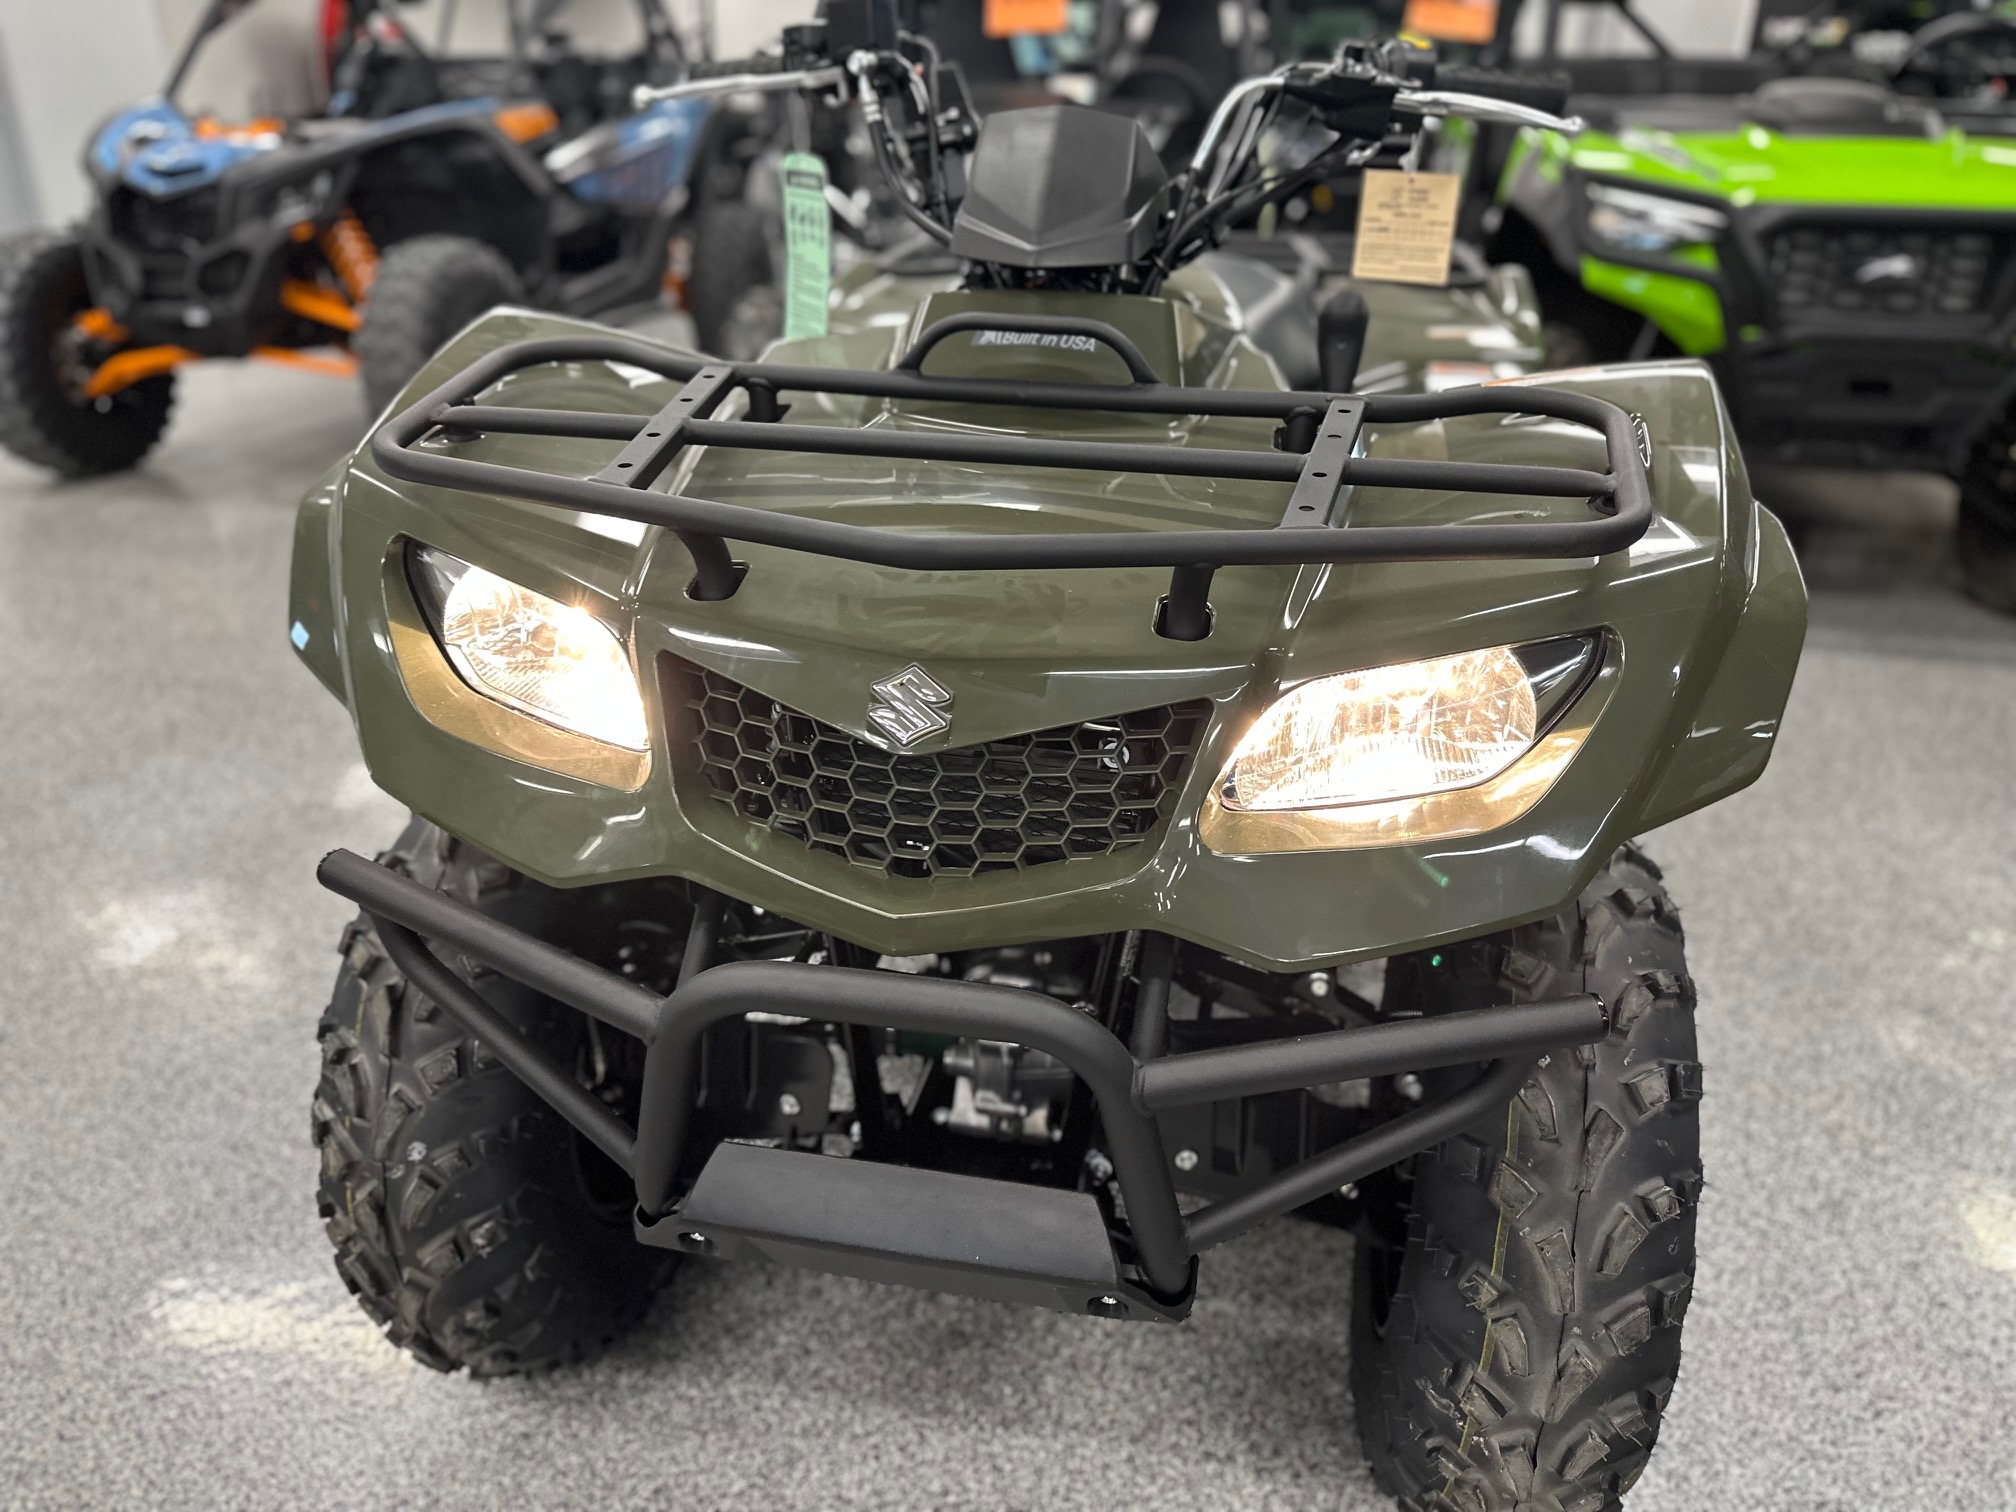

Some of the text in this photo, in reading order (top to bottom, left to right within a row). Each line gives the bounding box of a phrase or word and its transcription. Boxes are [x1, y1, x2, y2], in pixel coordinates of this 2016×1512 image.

[1002, 332, 1096, 352] Built in USA
